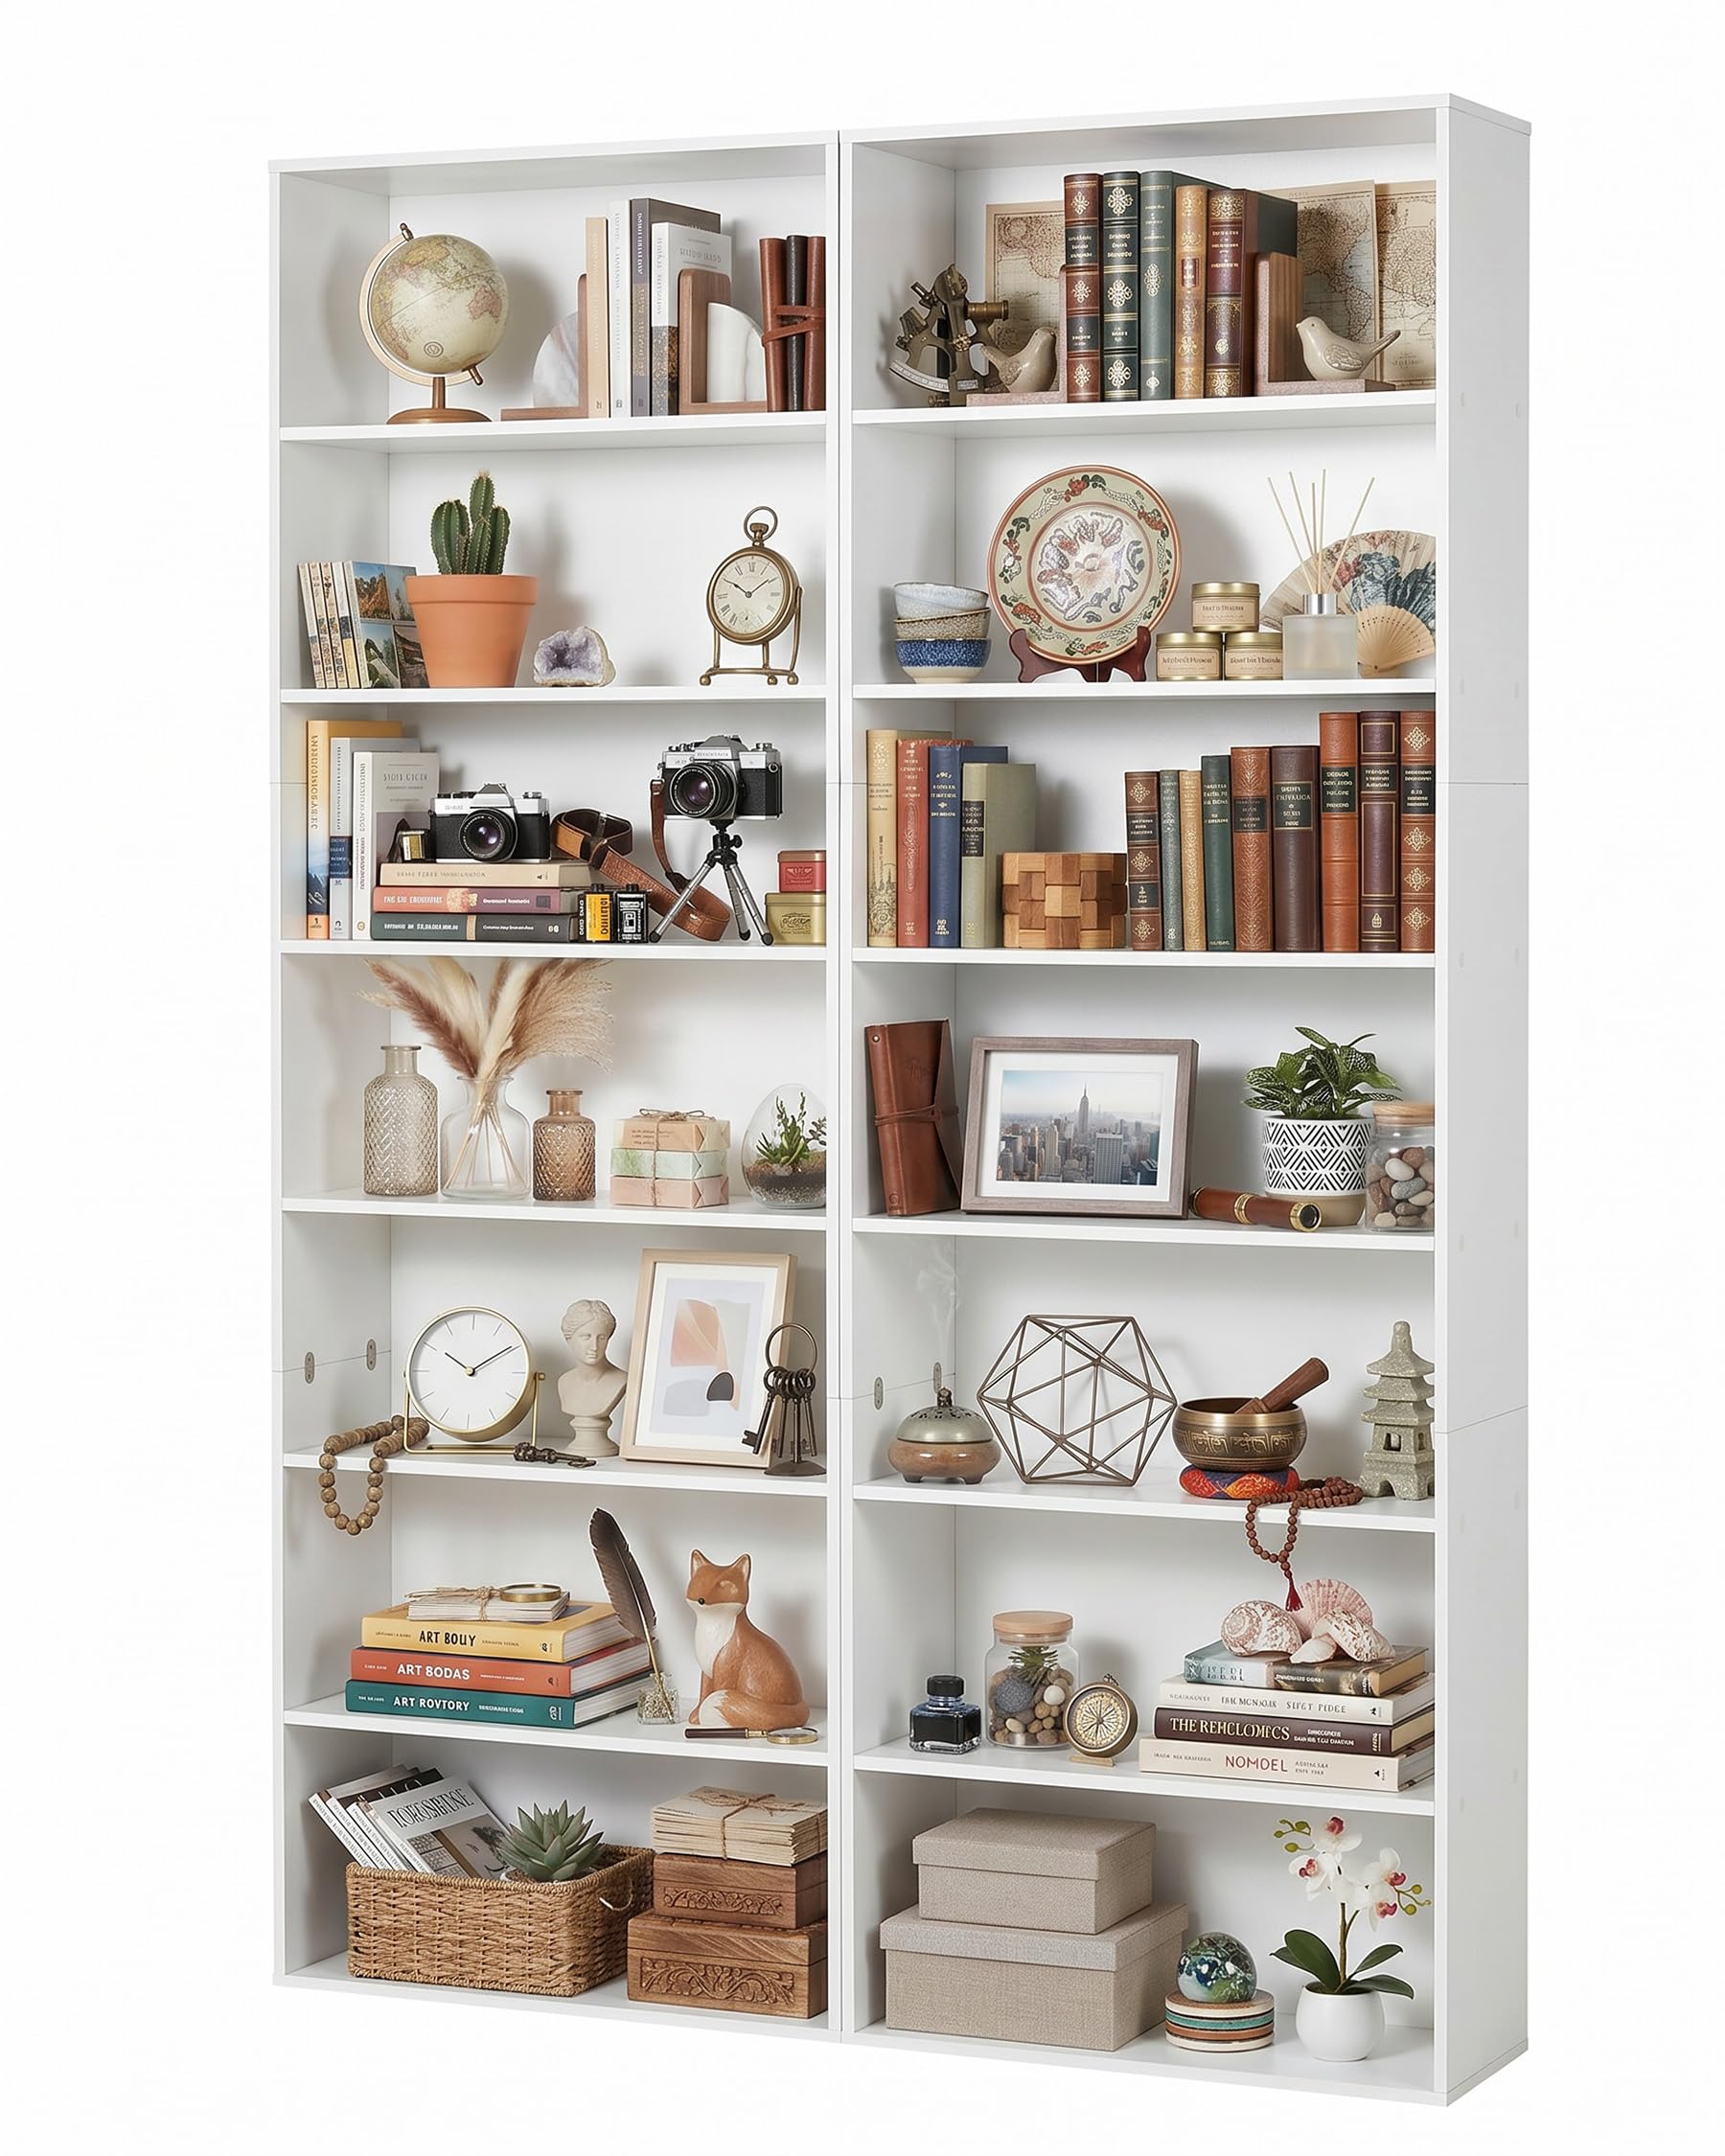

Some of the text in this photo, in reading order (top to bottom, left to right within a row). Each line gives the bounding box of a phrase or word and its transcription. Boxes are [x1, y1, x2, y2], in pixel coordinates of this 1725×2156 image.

[419, 1630, 441, 1643] ART
[397, 1663, 423, 1676] ART
[393, 1696, 416, 1707] ART
[1169, 1717, 1197, 1732] THE
